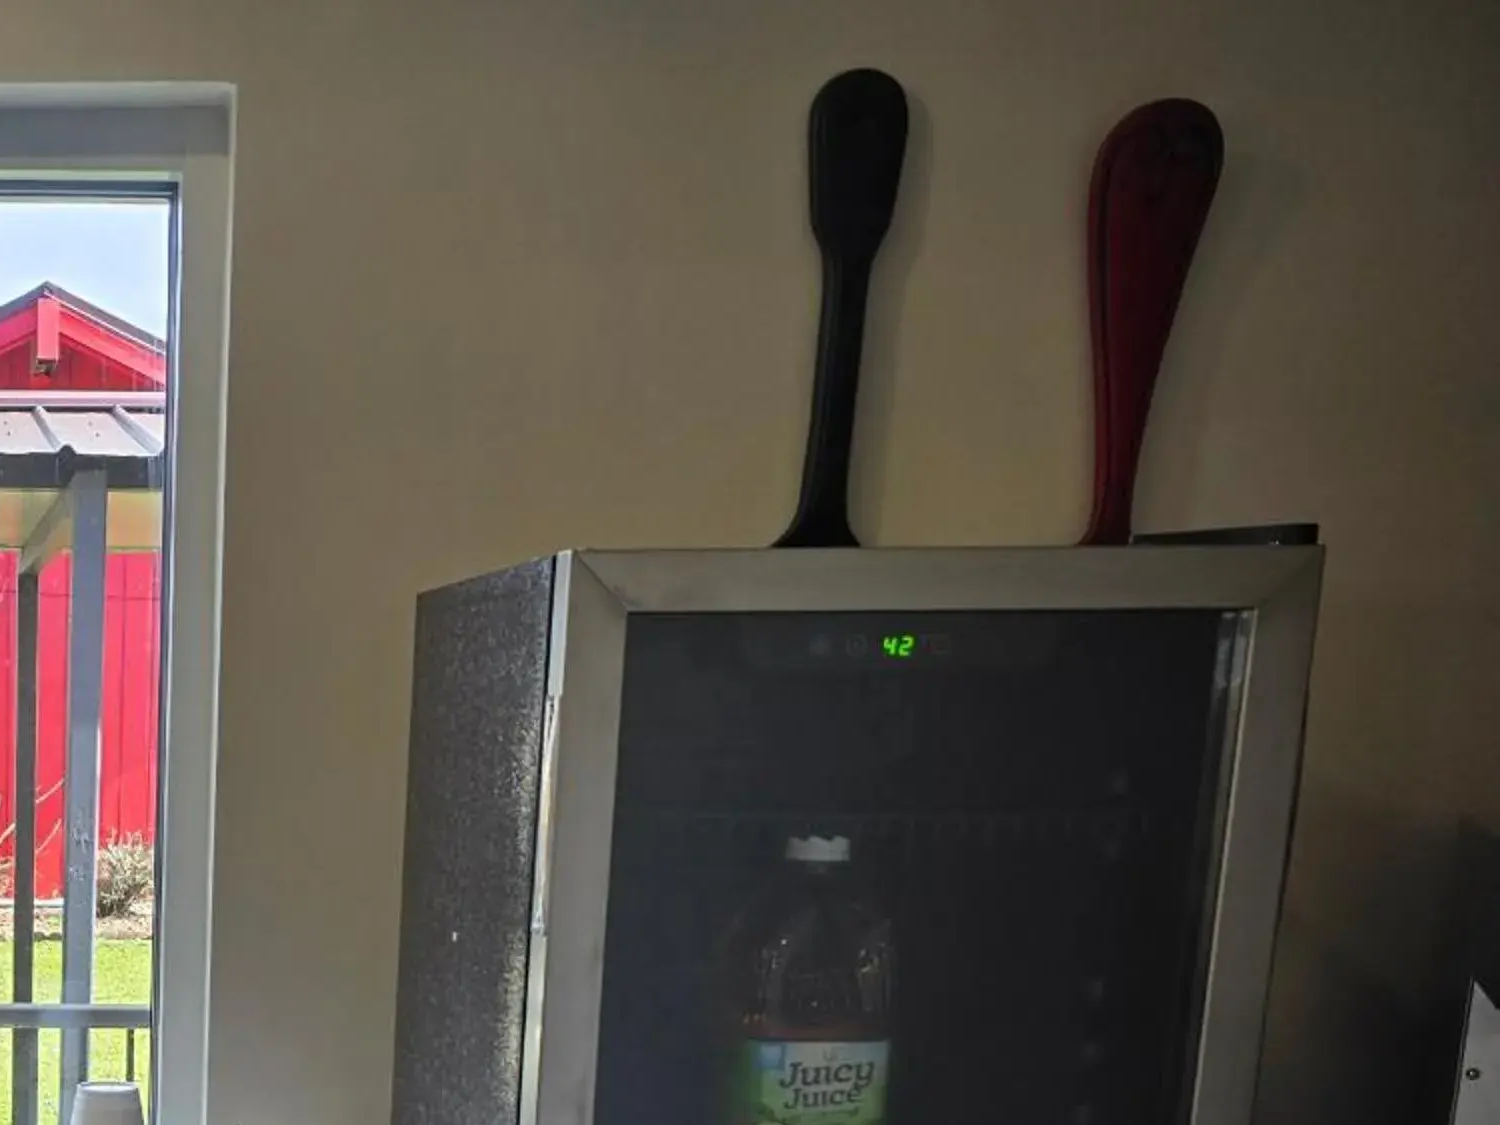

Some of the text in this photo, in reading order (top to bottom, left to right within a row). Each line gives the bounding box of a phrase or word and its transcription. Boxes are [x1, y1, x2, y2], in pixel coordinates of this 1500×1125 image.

[882, 634, 916, 656] 42
[779, 1061, 875, 1090] Juicy
[783, 1086, 866, 1110] Juice
